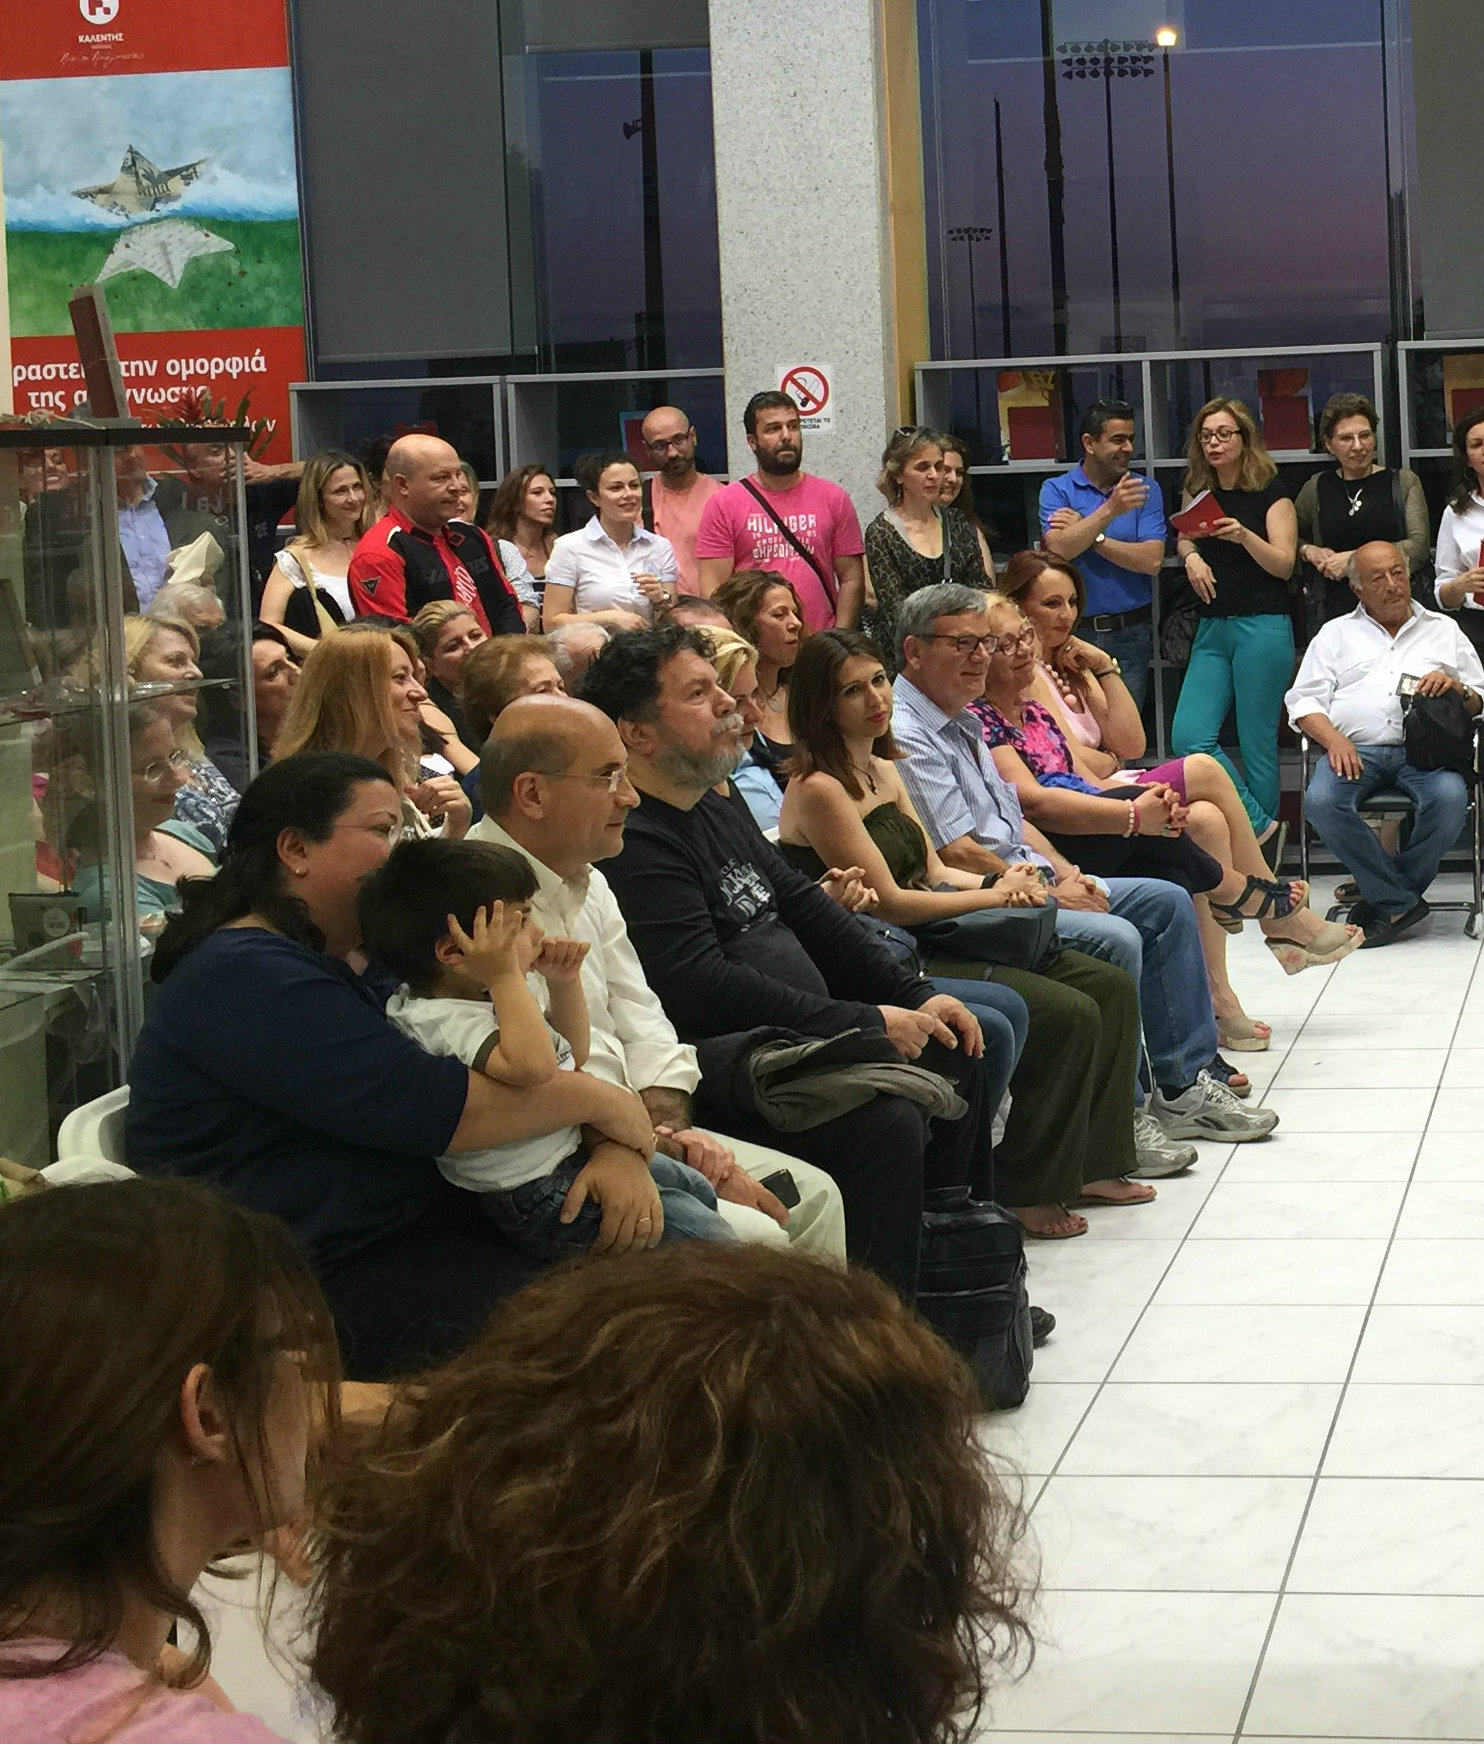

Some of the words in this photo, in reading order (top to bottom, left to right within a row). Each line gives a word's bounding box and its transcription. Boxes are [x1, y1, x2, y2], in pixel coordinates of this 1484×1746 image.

[78, 32, 124, 44] ΚΑΛΕΝΤΗΣ
[119, 359, 158, 378] την
[166, 348, 267, 381] ομορφιά
[27, 390, 67, 412] της
